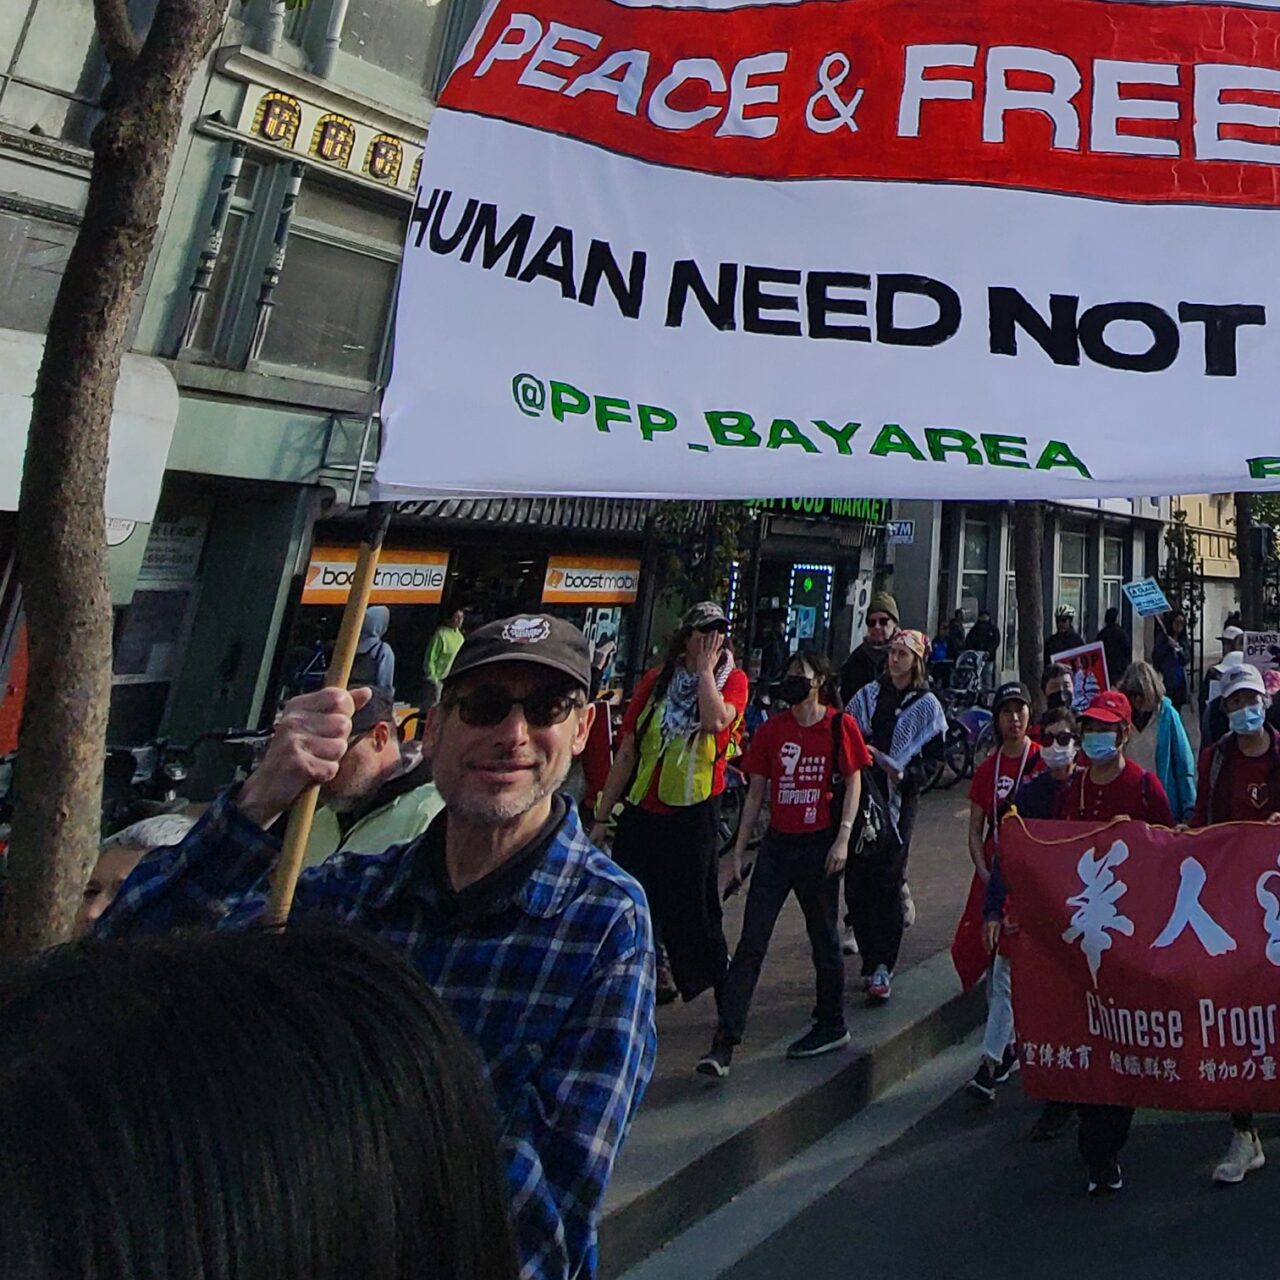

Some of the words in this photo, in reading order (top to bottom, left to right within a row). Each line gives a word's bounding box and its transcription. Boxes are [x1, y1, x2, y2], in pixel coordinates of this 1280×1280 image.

[473, 12, 788, 139] PEACE
[805, 51, 864, 134] &
[408, 186, 647, 320] HUMAN
[665, 259, 962, 347] NEED
[987, 286, 1266, 377] NOT
[322, 567, 443, 587] botmobile
[1247, 644, 1266, 656] OFF
[1086, 990, 1184, 1049] Chinese
